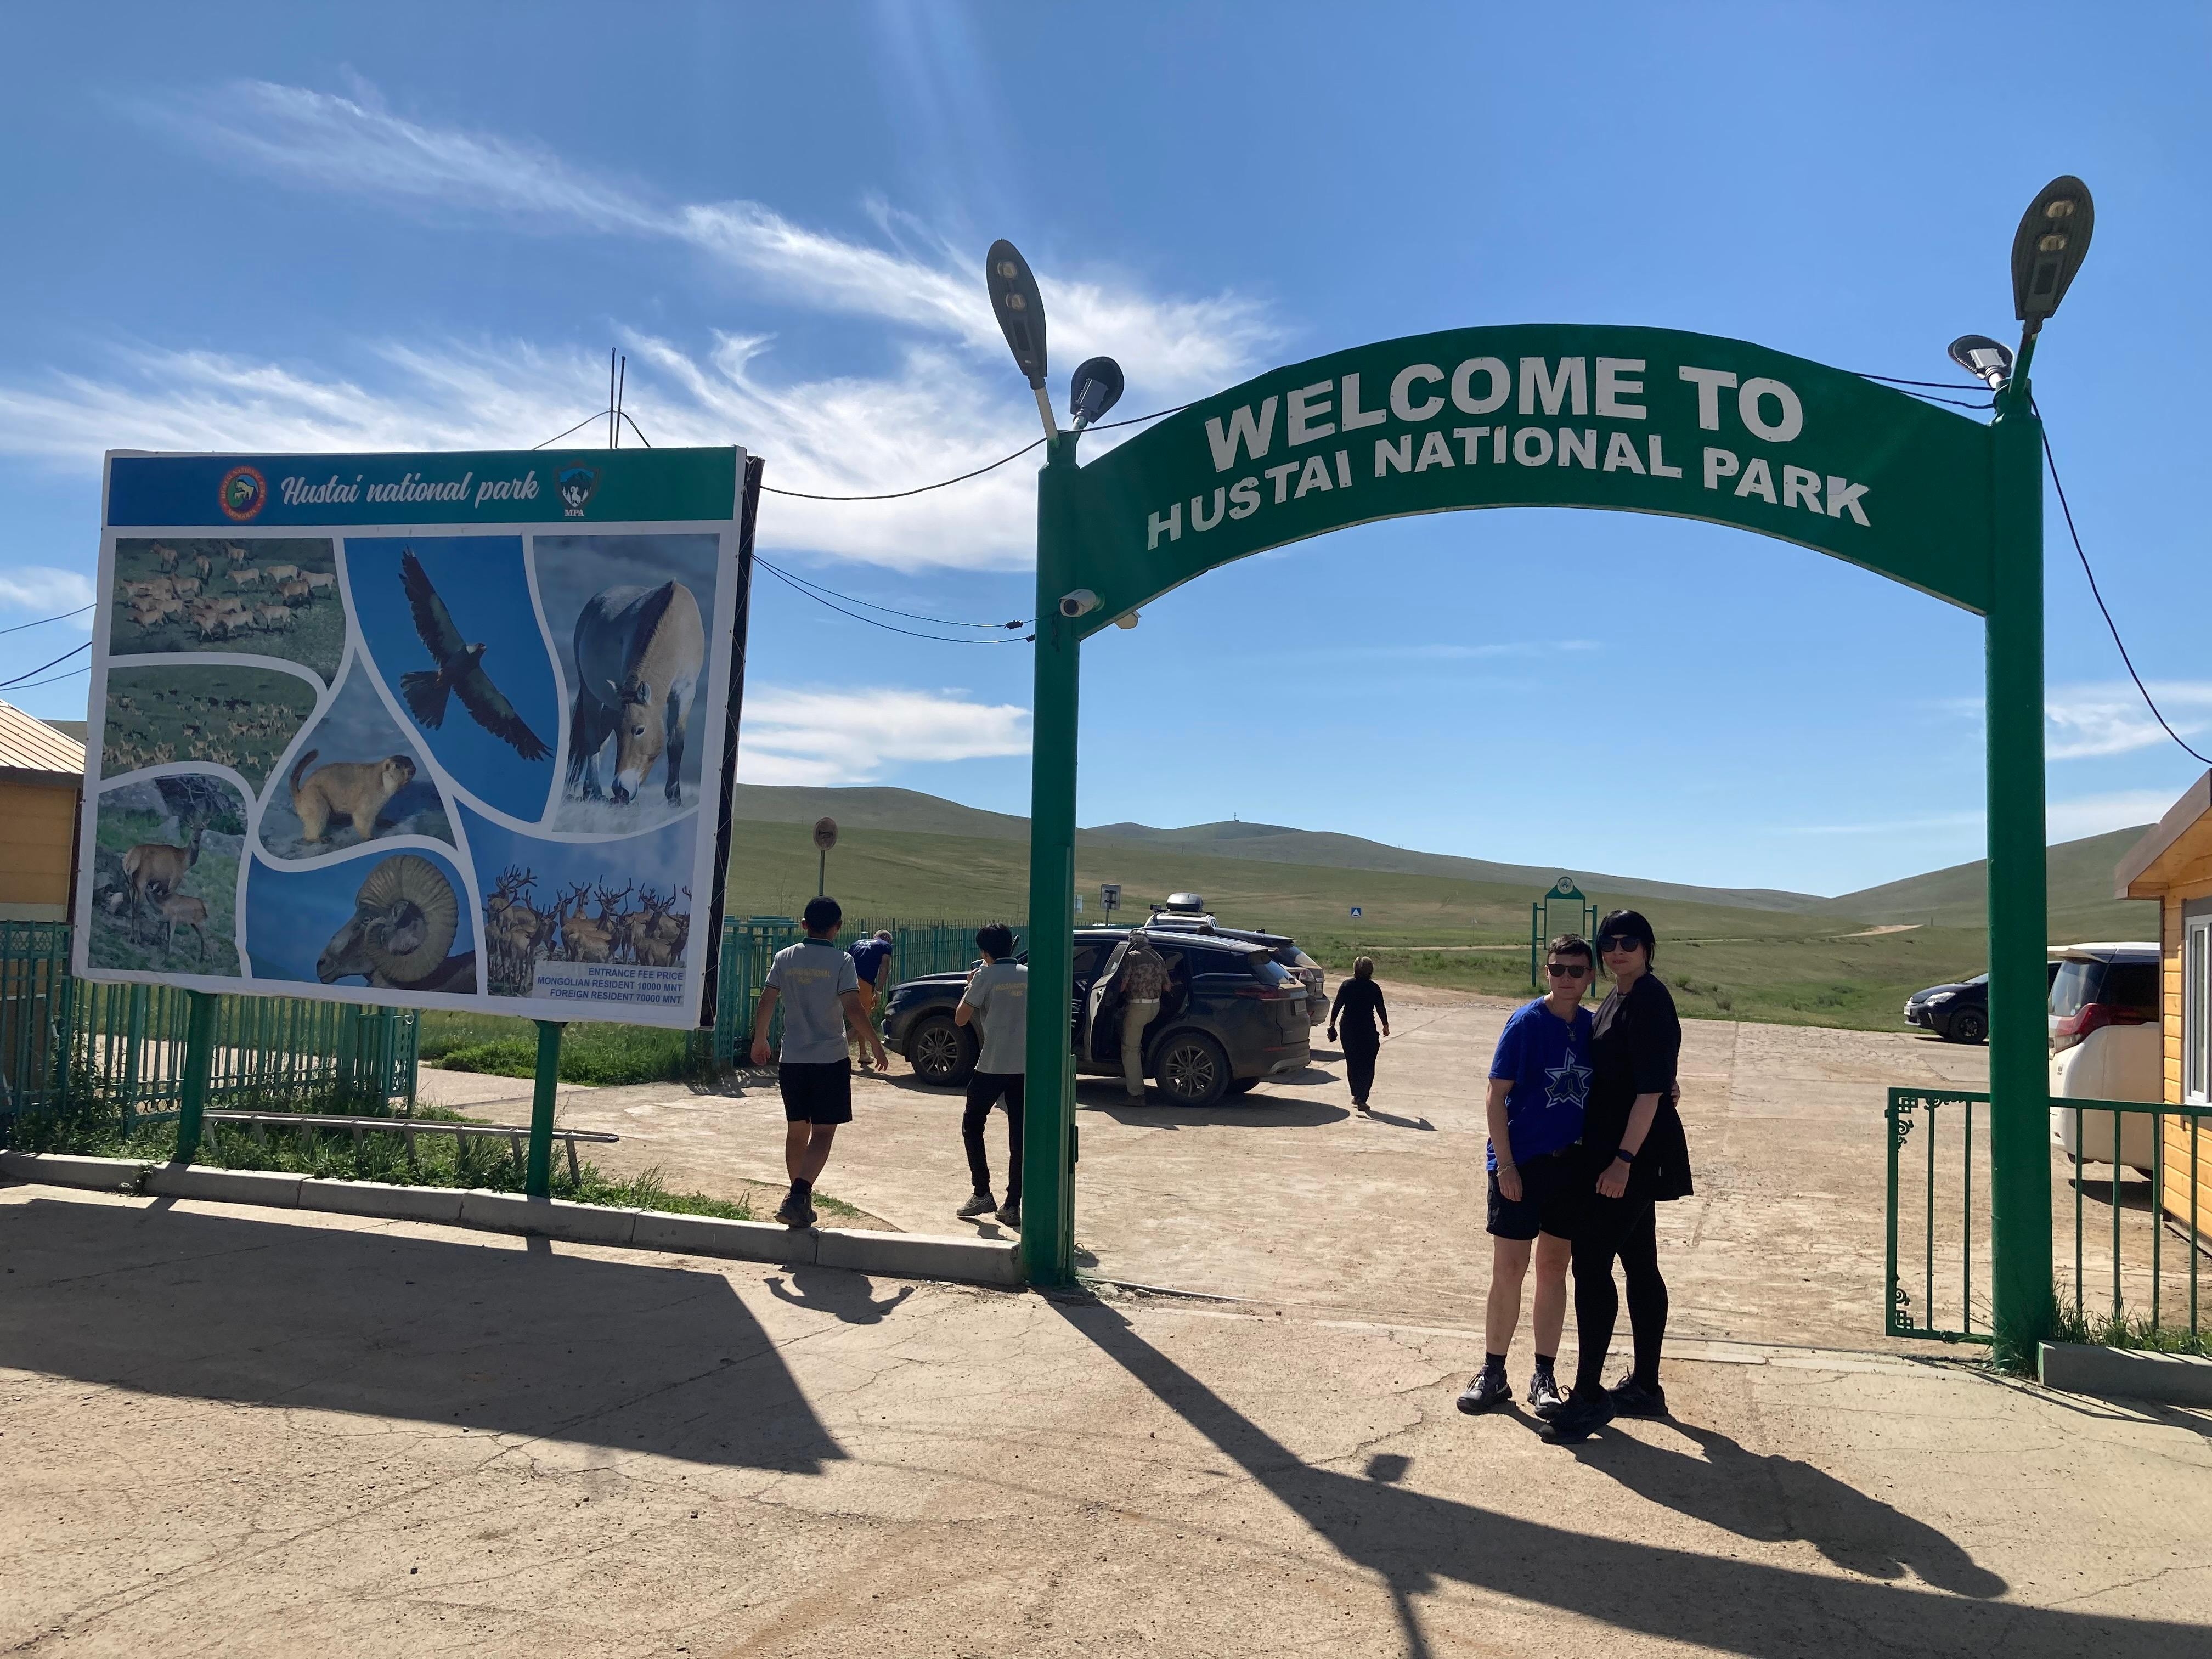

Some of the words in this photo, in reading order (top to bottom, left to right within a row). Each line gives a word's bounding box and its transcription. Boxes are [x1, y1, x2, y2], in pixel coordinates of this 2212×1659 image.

[1205, 357, 1647, 473] WELCOME
[1679, 365, 1803, 442] TO
[281, 475, 363, 505] Hustai
[366, 471, 473, 503] national
[475, 470, 540, 509] park
[1147, 449, 1353, 551] HUSTAI
[1374, 425, 1683, 479] NATIONAL
[1703, 447, 1871, 527] PARK
[537, 977, 590, 987] MONGOLIAN
[592, 979, 635, 990] RESIDENT
[637, 982, 661, 991] 10000
[663, 983, 684, 992] MNT
[589, 968, 635, 978] ENTRANCE
[637, 970, 654, 979] FEE
[657, 971, 684, 980] PRICE
[550, 989, 589, 998] FOREIGN
[591, 991, 634, 1001] RESIDENT
[636, 994, 661, 1003] 70000
[662, 995, 682, 1004] MNT
